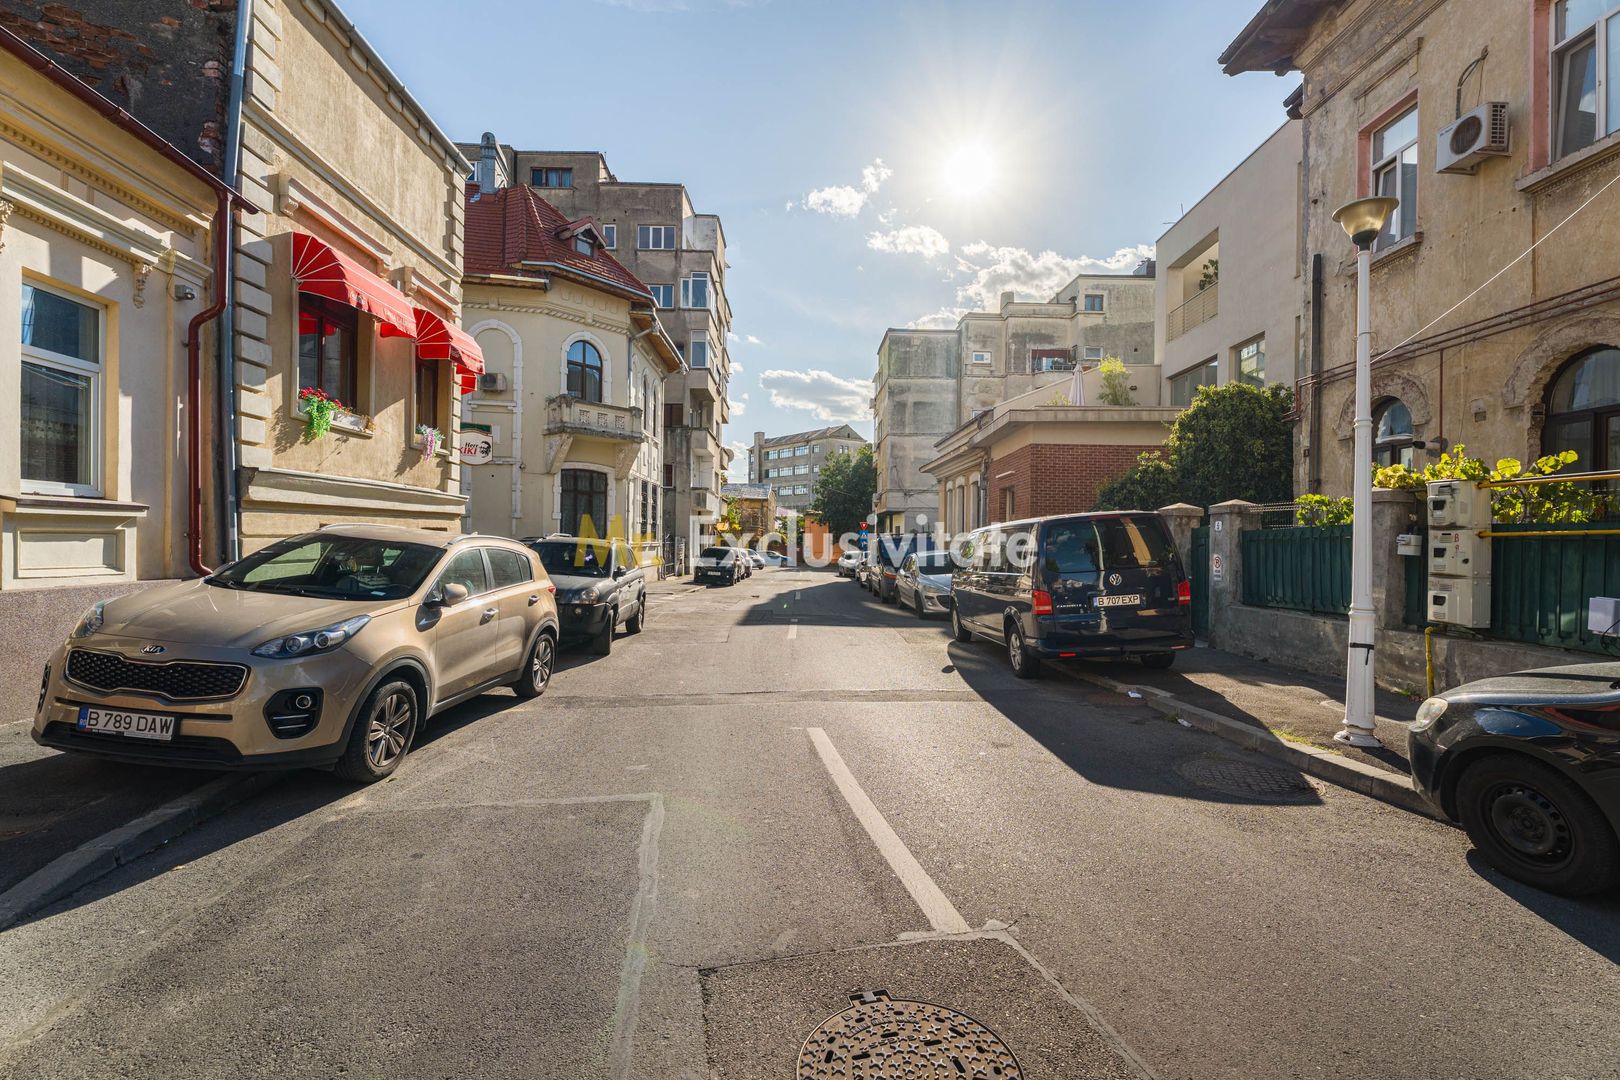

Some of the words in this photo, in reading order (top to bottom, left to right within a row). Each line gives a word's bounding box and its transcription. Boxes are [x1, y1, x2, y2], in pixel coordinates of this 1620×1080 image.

[1098, 598, 1105, 606] B
[1106, 597, 1120, 605] 707
[1121, 595, 1139, 604] EXP
[87, 711, 100, 727] B
[103, 713, 133, 730] 789
[136, 716, 173, 734] DAW
